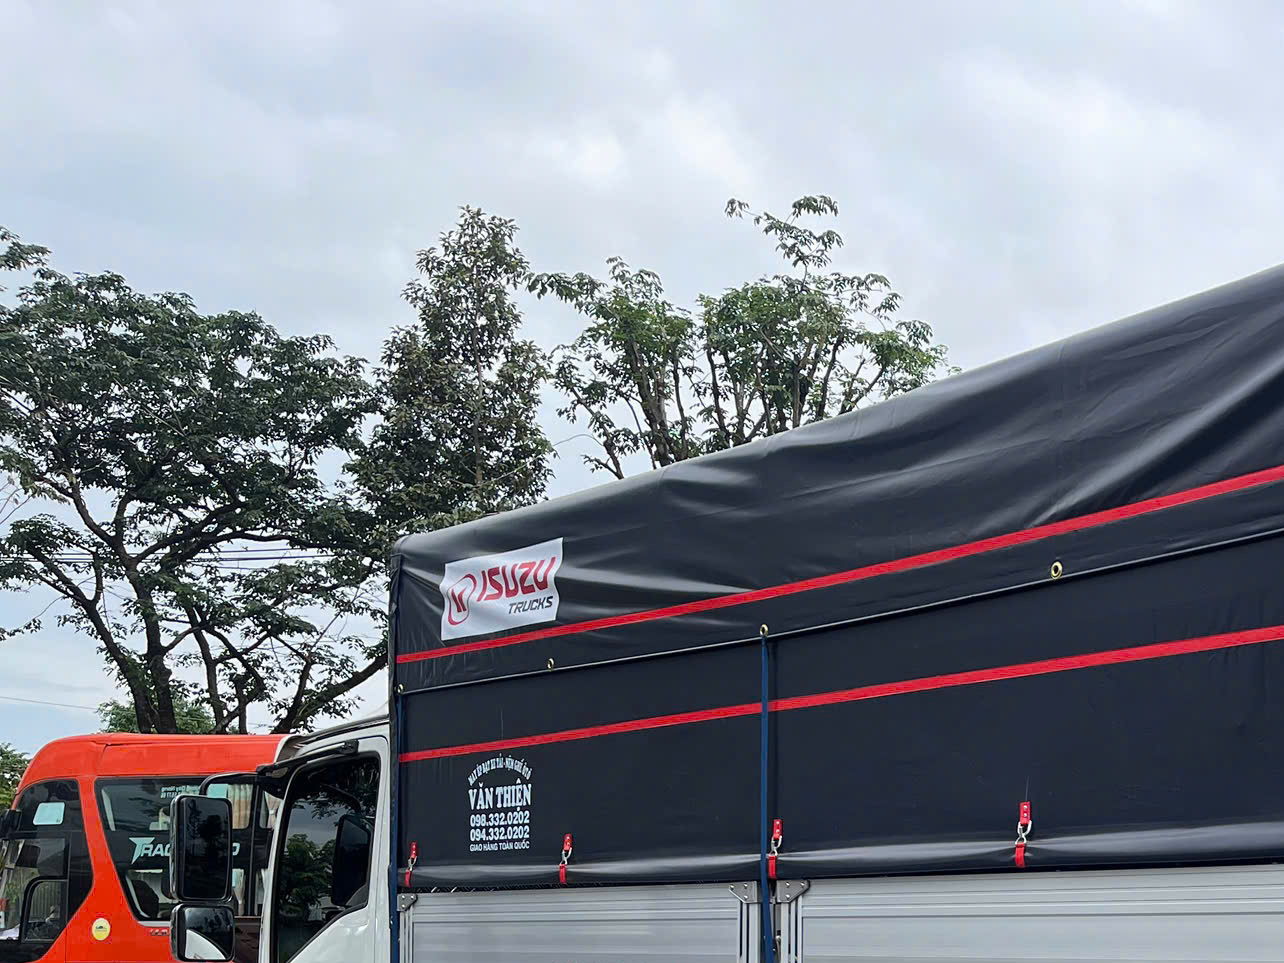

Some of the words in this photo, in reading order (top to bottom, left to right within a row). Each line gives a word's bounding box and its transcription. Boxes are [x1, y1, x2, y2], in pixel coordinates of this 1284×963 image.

[476, 556, 556, 602] ISUZU
[508, 596, 554, 614] TRUCKS
[468, 782, 494, 810] VĂN
[495, 778, 532, 811] THIỆN
[470, 810, 530, 827] 098.332.0202
[470, 825, 530, 841] 094.332.0202
[470, 843, 483, 852] GIAO
[483, 842, 499, 852] HÀNG
[499, 840, 514, 850] TOÀN
[514, 839, 530, 850] QUỐC
